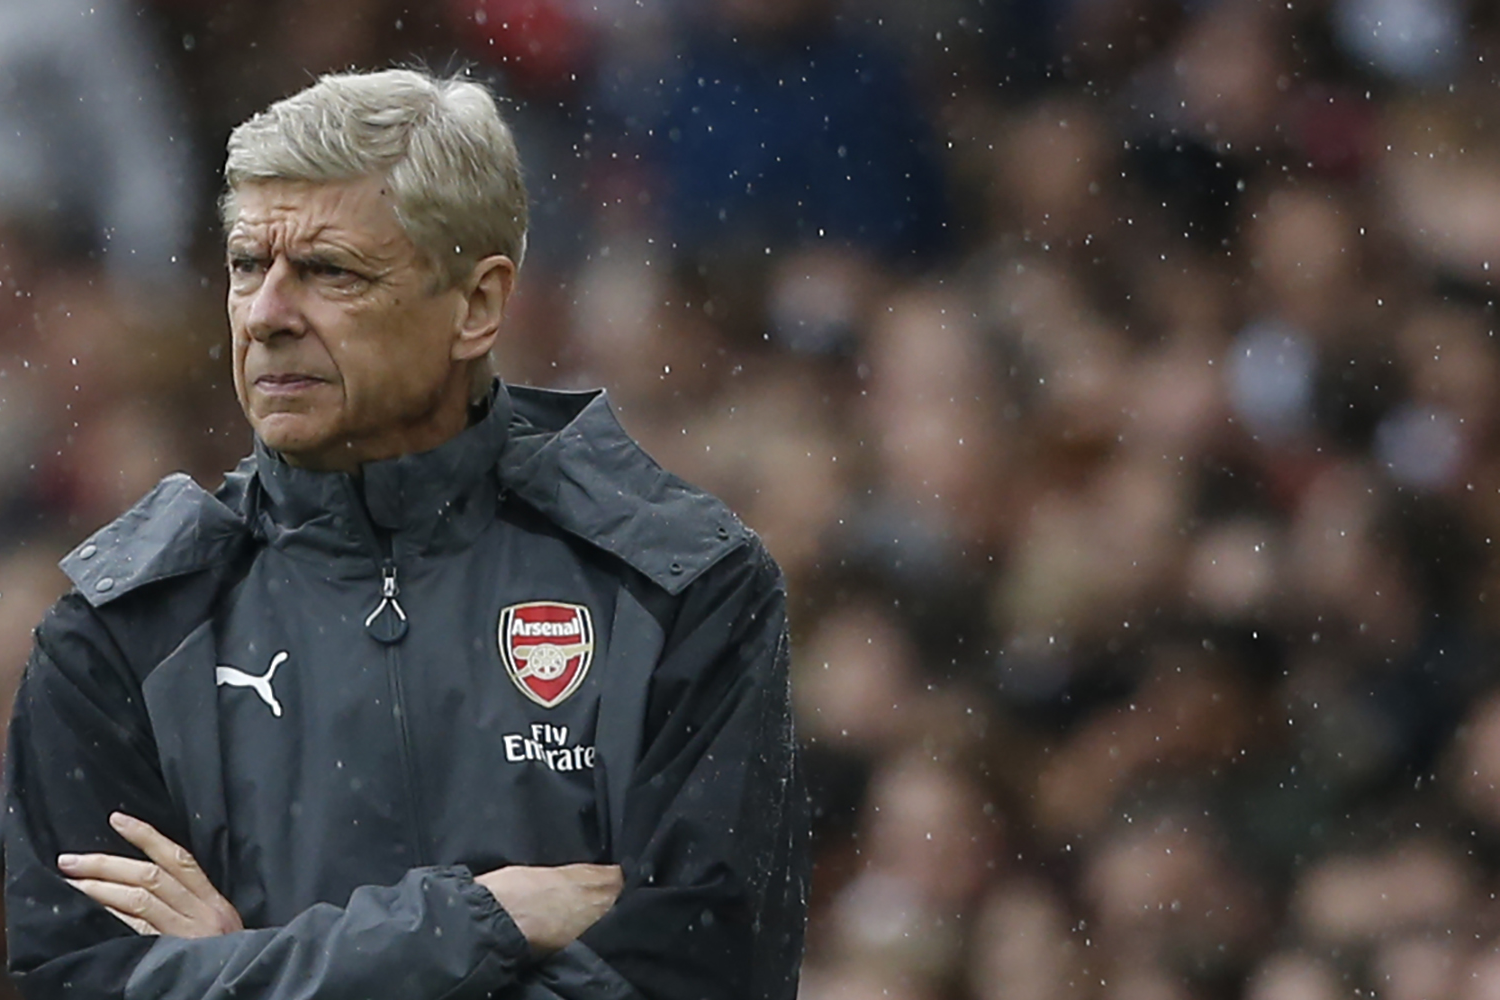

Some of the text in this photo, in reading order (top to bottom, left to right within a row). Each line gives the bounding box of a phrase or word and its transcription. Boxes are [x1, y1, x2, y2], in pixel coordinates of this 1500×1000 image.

[512, 617, 580, 637] Arsenal
[531, 723, 568, 746] Fly
[503, 734, 595, 771] Emirate
